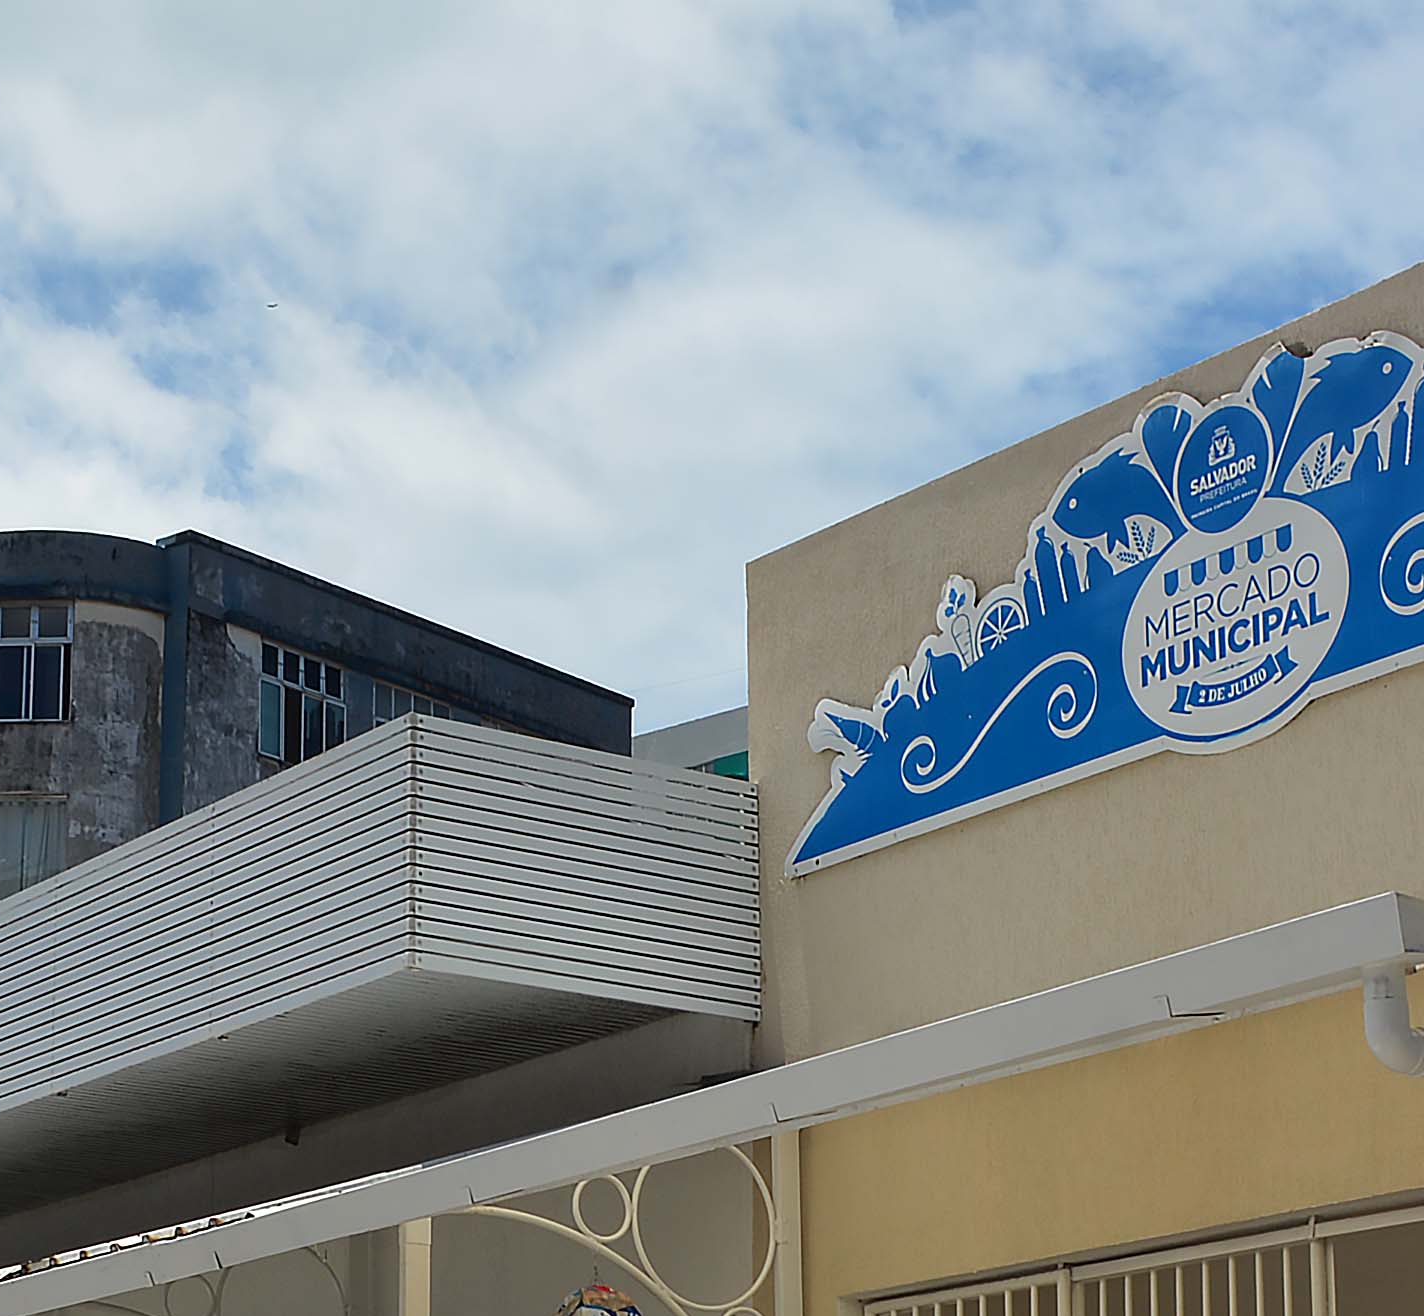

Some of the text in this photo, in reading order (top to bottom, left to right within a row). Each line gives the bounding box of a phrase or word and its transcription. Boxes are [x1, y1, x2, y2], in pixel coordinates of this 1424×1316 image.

[1190, 454, 1257, 496] SALVADOR
[1199, 476, 1248, 503] PREFEITURA
[1144, 552, 1321, 648] MERCADO
[1140, 591, 1330, 688] MUNICIPAL
[1198, 666, 1268, 704] 2 DE JULHO
